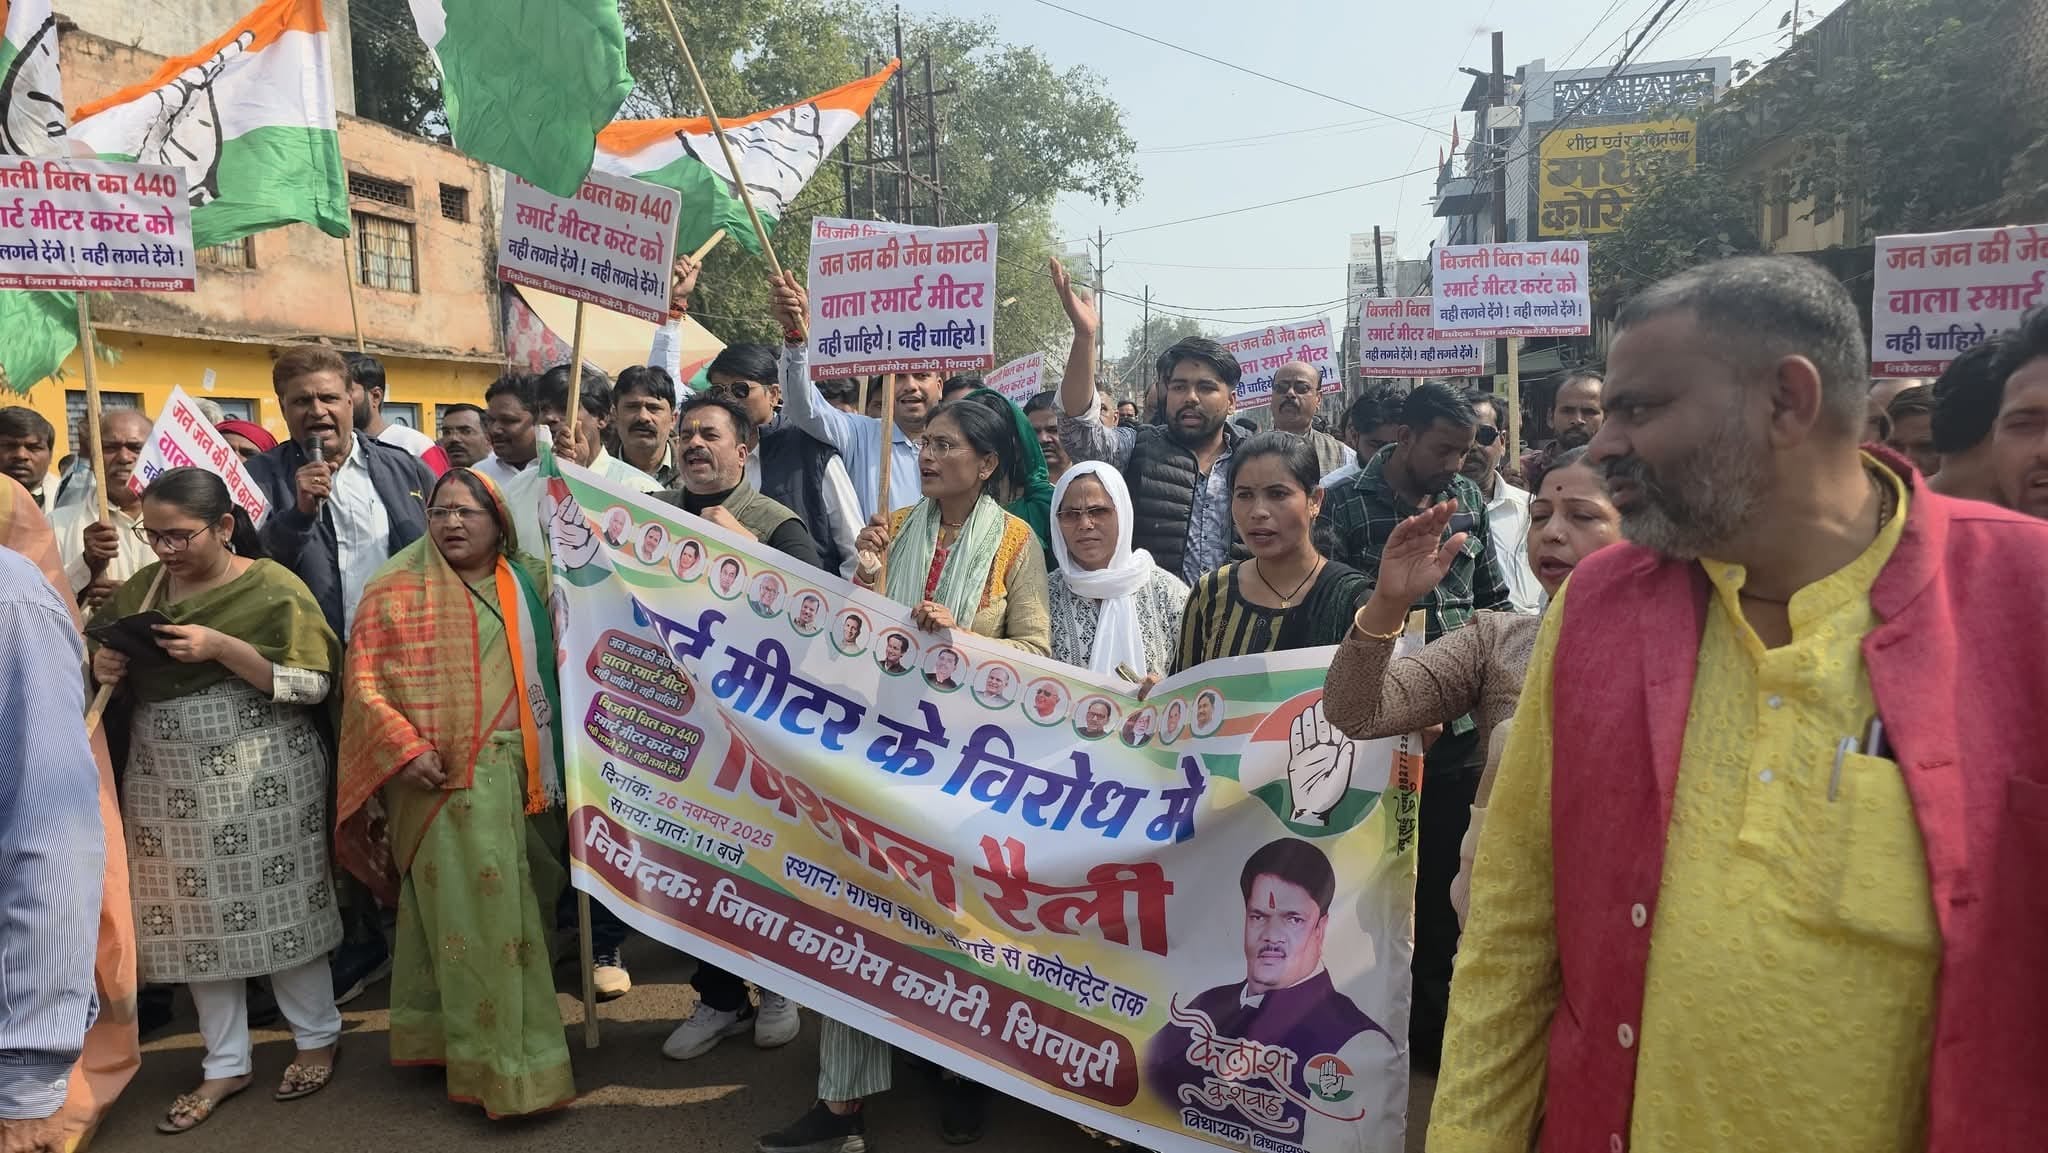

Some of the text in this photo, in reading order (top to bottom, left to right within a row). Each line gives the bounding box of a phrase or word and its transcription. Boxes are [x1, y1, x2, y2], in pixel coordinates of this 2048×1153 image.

[43, 161, 177, 198] बिल का 440
[29, 199, 175, 235] मीटर करंट को
[615, 189, 638, 215] का
[640, 194, 672, 225] 440
[40, 239, 66, 264] देंगे
[81, 242, 109, 266] नही
[112, 244, 149, 265] लगने
[152, 244, 176, 267] देंगे
[516, 203, 664, 265] स्मार्ट मीटर करंट को
[1886, 230, 2010, 270] जन जन की
[508, 236, 529, 262] नही
[531, 244, 558, 268] लगने
[591, 259, 612, 287] नही
[612, 268, 639, 291] लगने
[819, 229, 989, 278] जन जन की जेब काटने
[1440, 248, 1579, 271] बिजली बिल का 440
[821, 273, 985, 320] वाला स्मार्ट मीटर
[1443, 272, 1577, 298] स्मार्ट मीटर करंट को
[1888, 270, 2045, 315] वाला स्मार्ट
[1366, 300, 1402, 318] बिजली
[1440, 305, 1459, 322] नही
[1460, 303, 1486, 319] लगने
[1514, 302, 1532, 319] नही
[1533, 301, 1558, 317] लगने
[818, 318, 976, 357] नही चाहिये नही चाहिये
[1241, 337, 1259, 351] जन
[1261, 328, 1276, 346] की
[1297, 320, 1326, 339] काटने
[1367, 322, 1395, 341] स्मार्ट
[1397, 322, 1424, 341] मीटर
[1885, 325, 1922, 354] नही
[172, 400, 195, 434] जन
[193, 423, 214, 455] जन
[212, 444, 229, 471] की
[676, 727, 700, 745] 440
[711, 638, 868, 751] मीटर
[866, 699, 950, 777] के
[940, 723, 1151, 839] विरोध
[655, 791, 679, 811] 26
[731, 821, 774, 848] 2025
[695, 833, 713, 853] 11
[717, 840, 745, 870] बजे
[974, 834, 1174, 957] रैली
[845, 879, 895, 920] माधव
[1001, 943, 1022, 970] से
[1111, 985, 1148, 1017] तक
[705, 877, 790, 942] जिला
[788, 922, 896, 987] कांग्रेस
[1000, 1000, 1120, 1089] शिवपुरी
